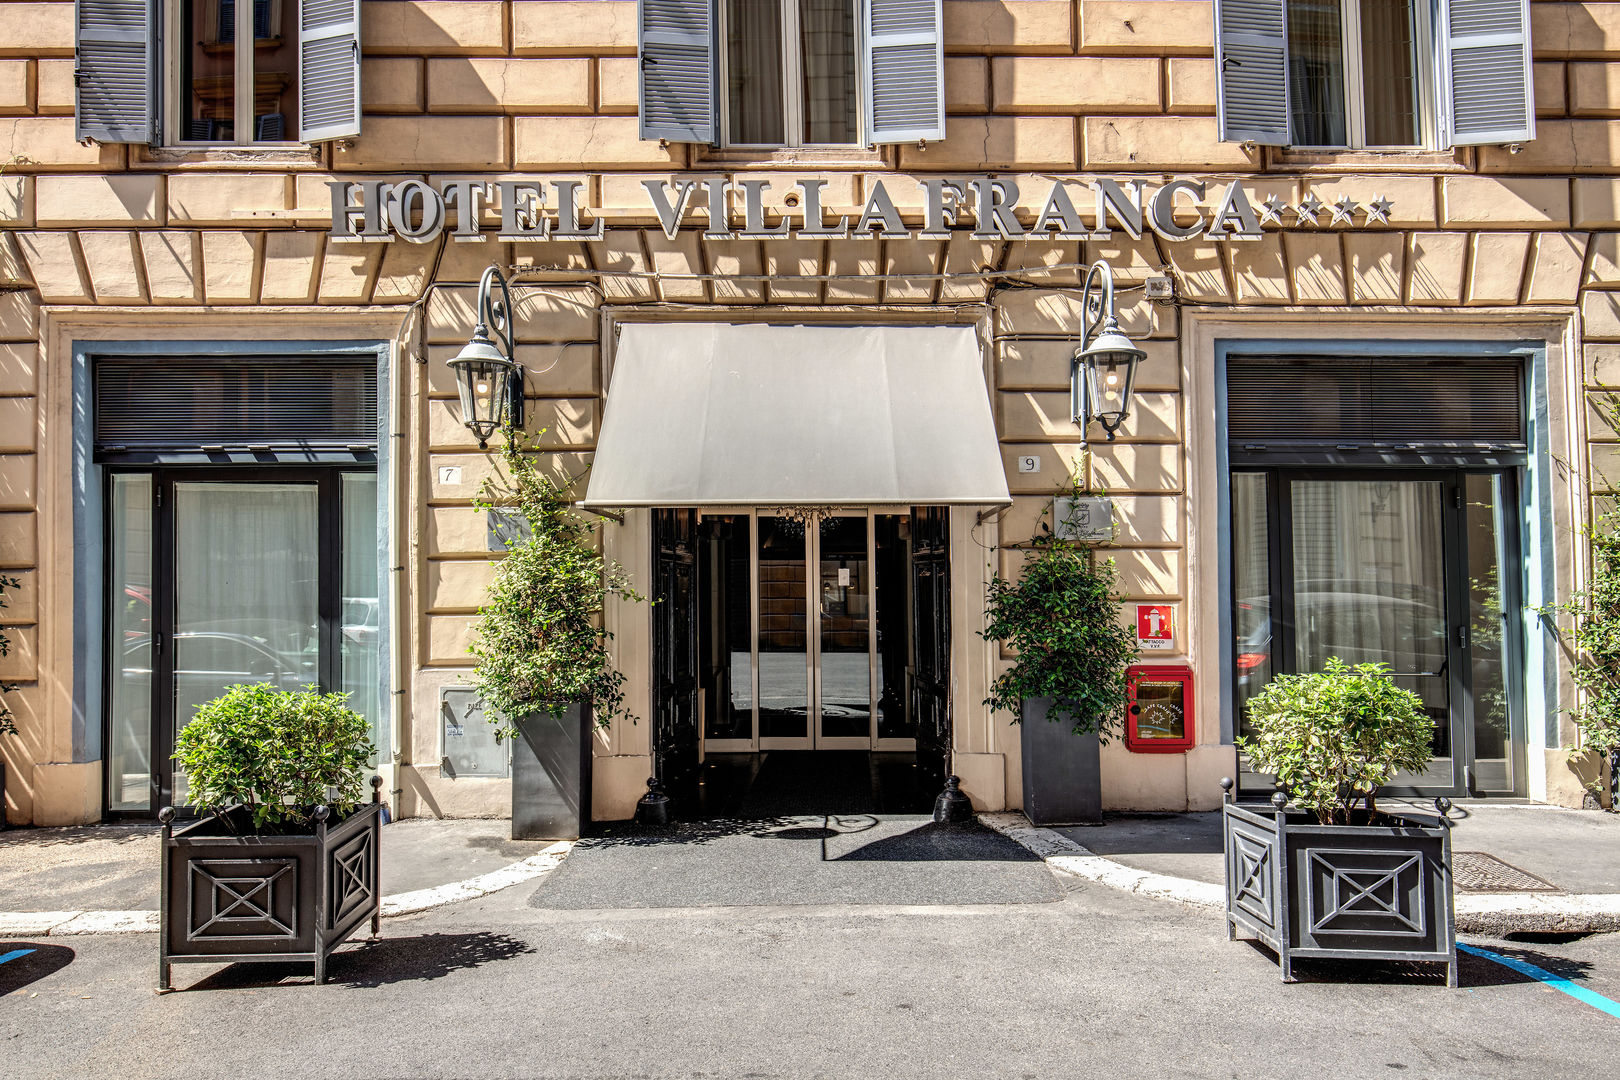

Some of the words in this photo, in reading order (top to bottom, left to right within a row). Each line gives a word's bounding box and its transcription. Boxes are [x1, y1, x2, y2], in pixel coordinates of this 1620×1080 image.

[324, 179, 605, 243] HOTEL
[640, 178, 1265, 243] VILLAFRANCA
[1025, 458, 1035, 471] 9
[445, 468, 454, 481] 7
